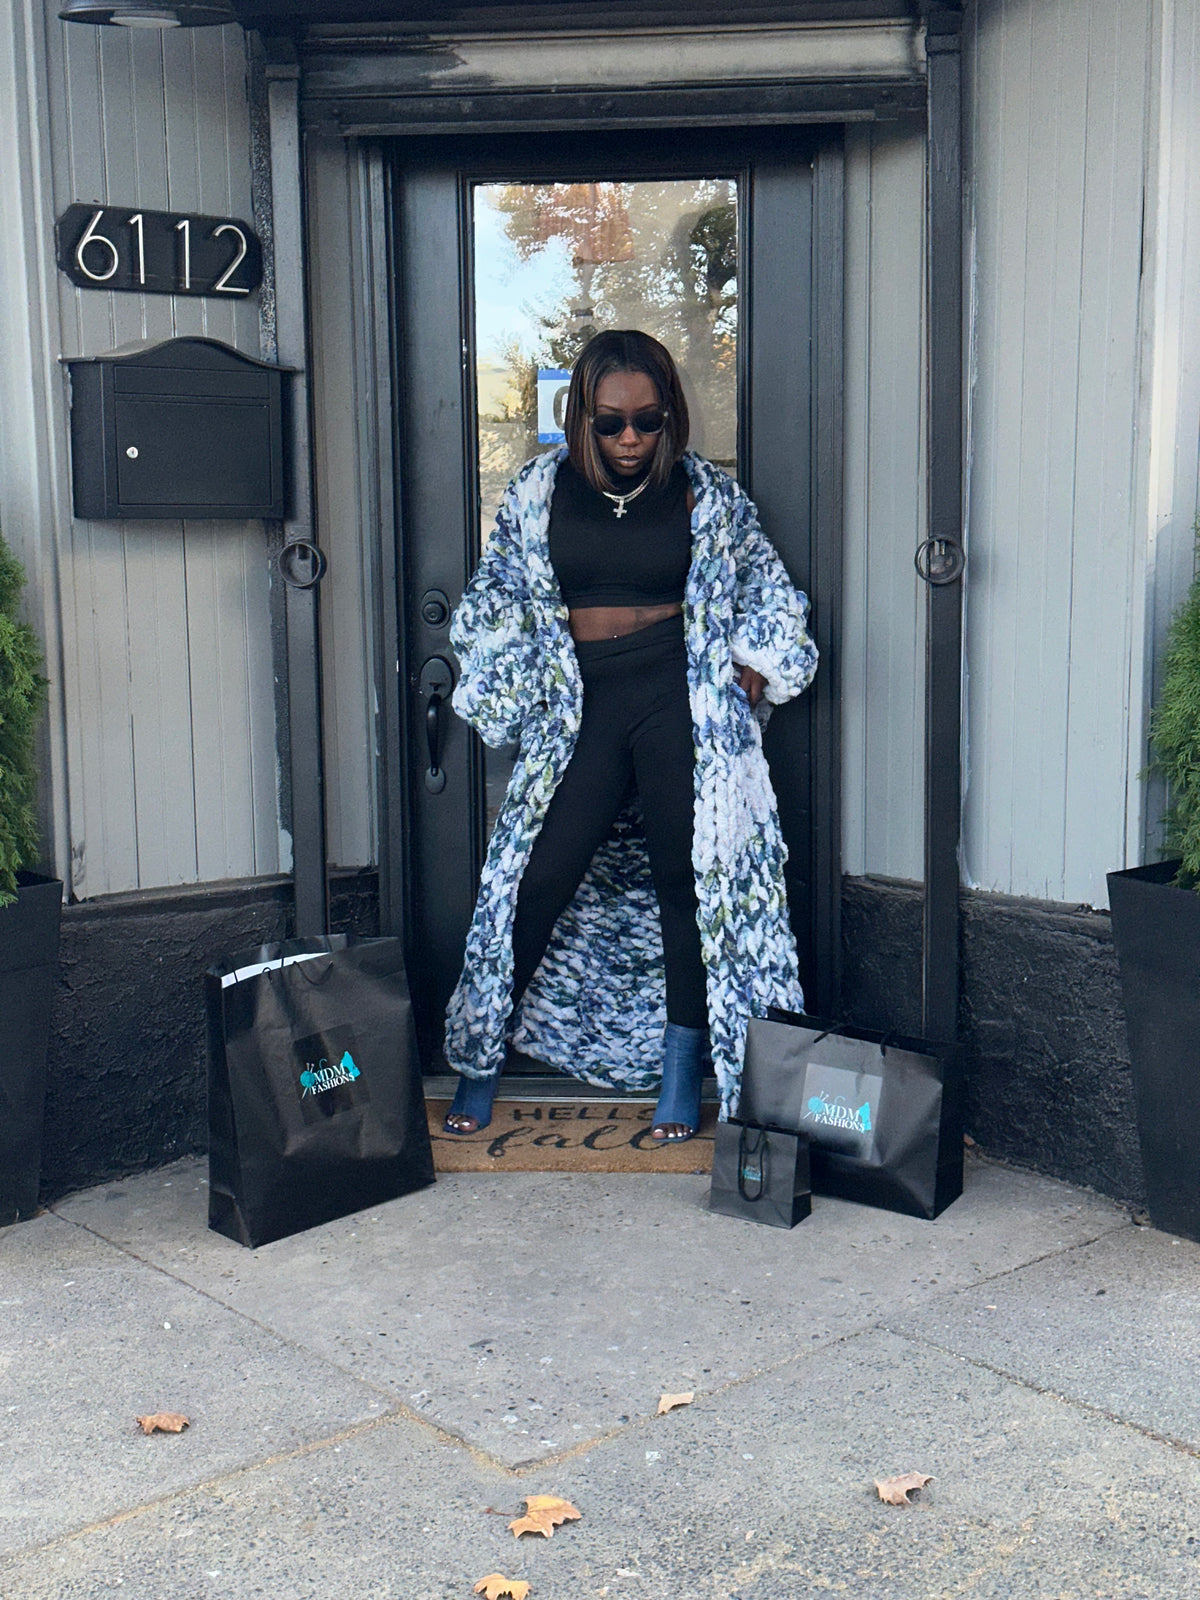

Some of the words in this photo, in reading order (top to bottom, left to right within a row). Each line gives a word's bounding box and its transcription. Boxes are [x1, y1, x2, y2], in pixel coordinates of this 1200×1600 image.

[76, 210, 250, 293] 6112
[311, 1072, 356, 1095] FASHIONS
[313, 1062, 346, 1084] MDM
[823, 1102, 860, 1121] MDM
[814, 1113, 865, 1133] FASHIONS
